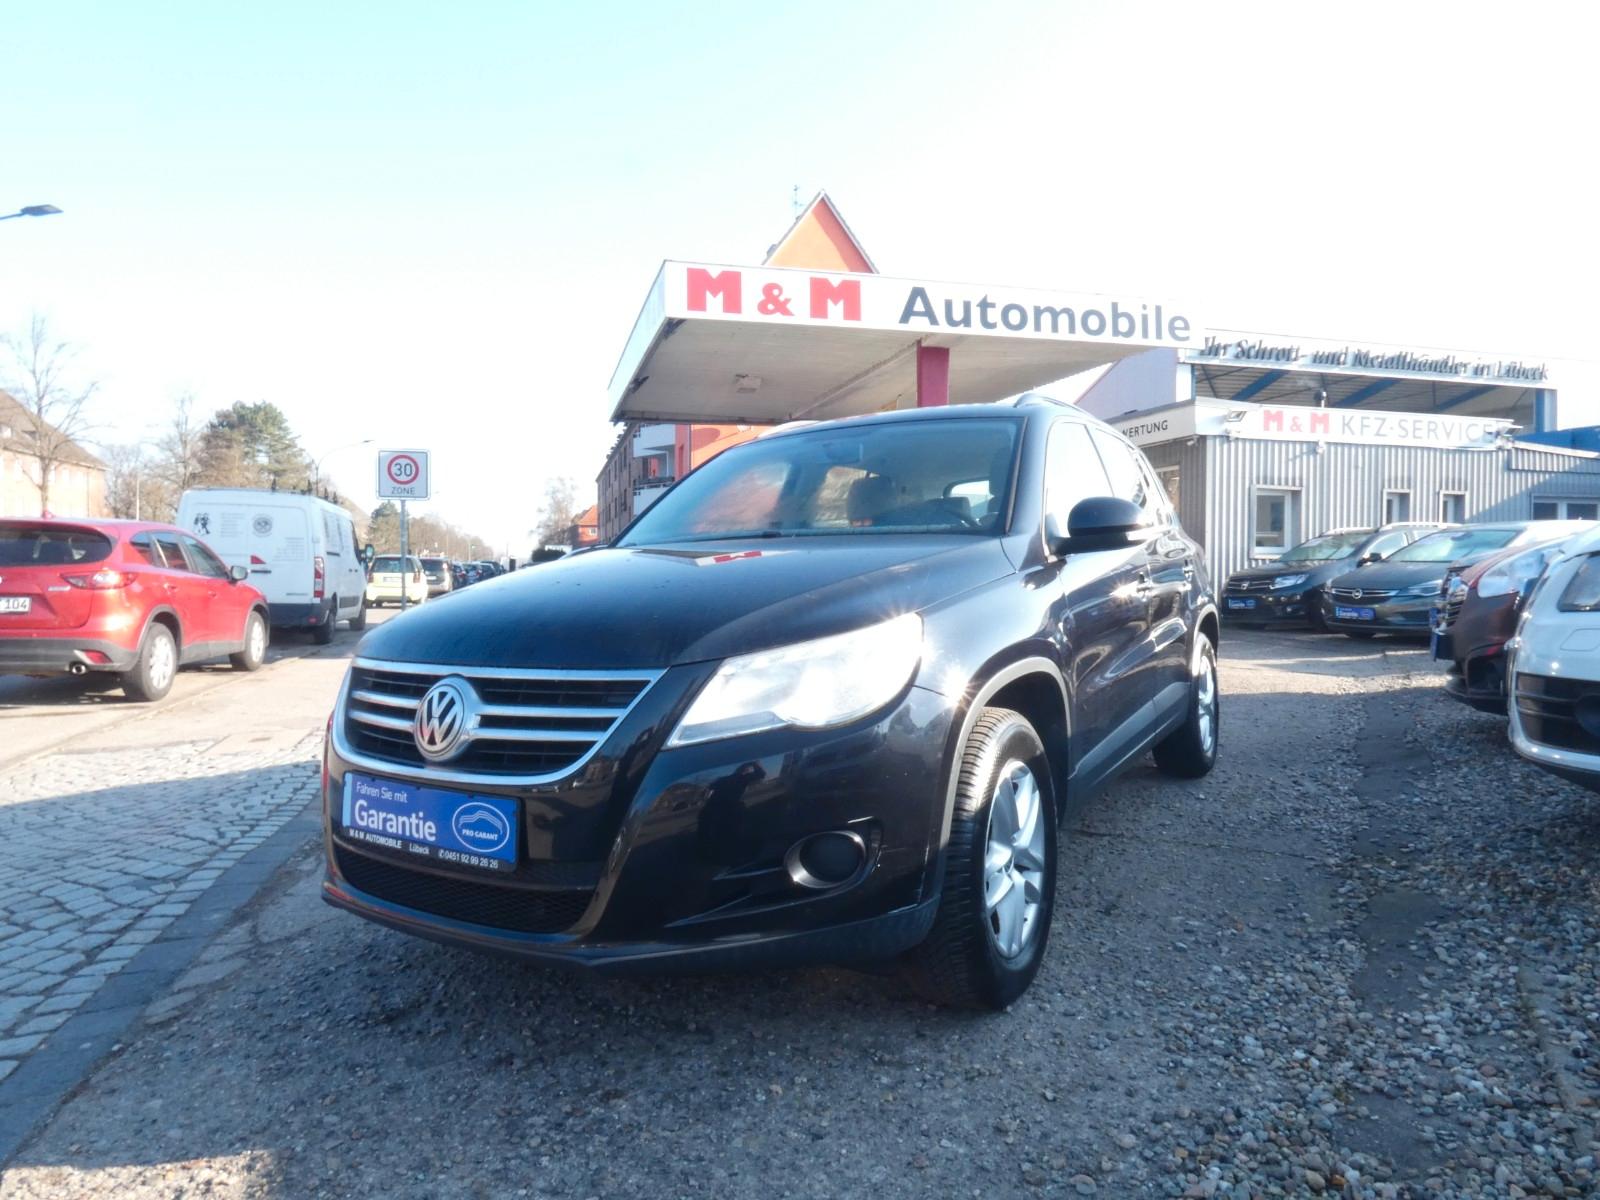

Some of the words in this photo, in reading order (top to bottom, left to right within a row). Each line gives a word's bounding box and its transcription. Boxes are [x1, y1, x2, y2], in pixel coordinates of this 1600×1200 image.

[687, 267, 742, 314] M
[757, 282, 795, 317] &
[808, 276, 862, 322] M
[898, 286, 1191, 342] Automobile
[1200, 336, 1232, 357] Ihr
[1312, 347, 1350, 366] und
[1474, 357, 1491, 376] in
[1263, 410, 1283, 432] M
[1289, 416, 1302, 432] &
[1310, 412, 1330, 434] M
[394, 462, 413, 477] 30
[391, 486, 416, 495] ZONE
[356, 782, 380, 798] Fahren
[381, 787, 393, 800] Sie
[394, 791, 408, 803] mit
[355, 799, 436, 842] Garantie
[366, 833, 402, 848] AUTOMOBILE
